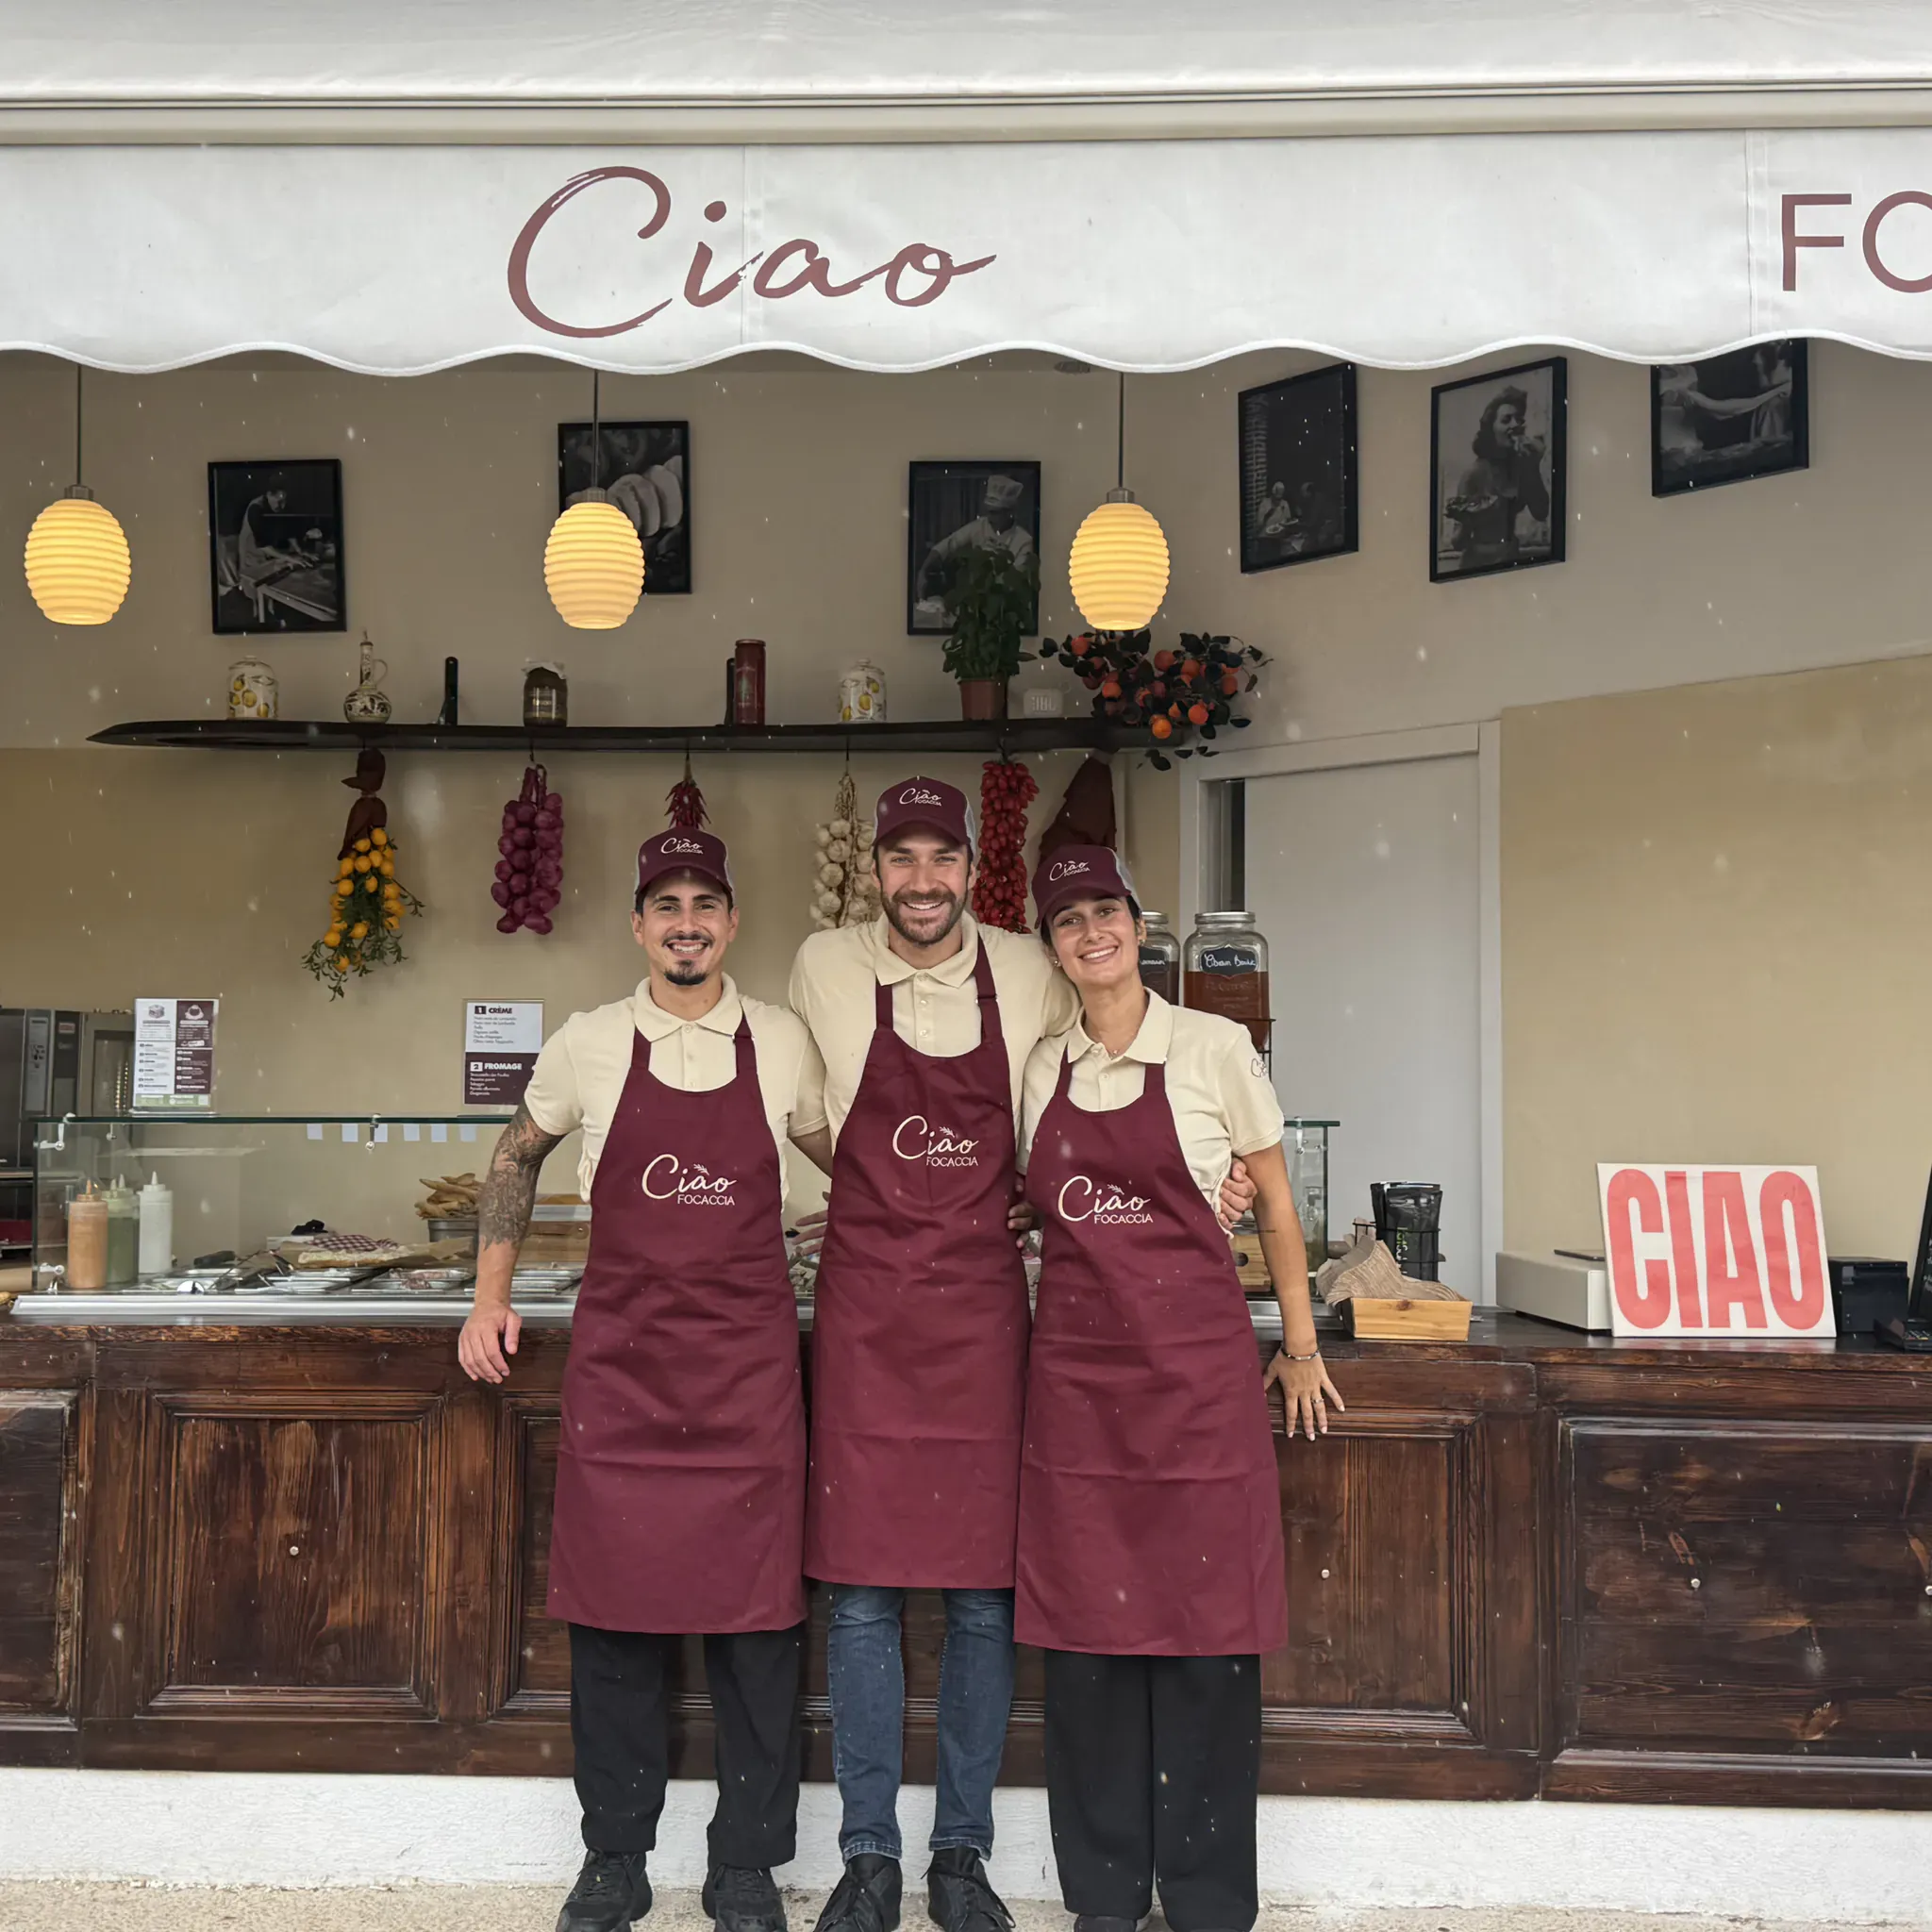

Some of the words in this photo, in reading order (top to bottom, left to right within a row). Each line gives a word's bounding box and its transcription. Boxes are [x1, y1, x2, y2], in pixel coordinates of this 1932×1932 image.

[508, 166, 997, 339] Ciao
[1031, 696, 1057, 711] JBL
[899, 788, 942, 805] Ciao
[661, 838, 704, 854] Ciao
[1049, 860, 1090, 882] Ciao
[488, 1005, 513, 1015] CRÈME
[484, 1062, 523, 1071] FROMAGE
[892, 1115, 979, 1159] Ciao
[925, 1156, 979, 1167] FOCACCIA
[641, 1154, 738, 1199] Ciao
[677, 1193, 736, 1206] FOCACCIA
[1058, 1175, 1152, 1222] Ciao
[1093, 1213, 1154, 1224] FOCACCIA
[1607, 1169, 1824, 1330] CIAO
